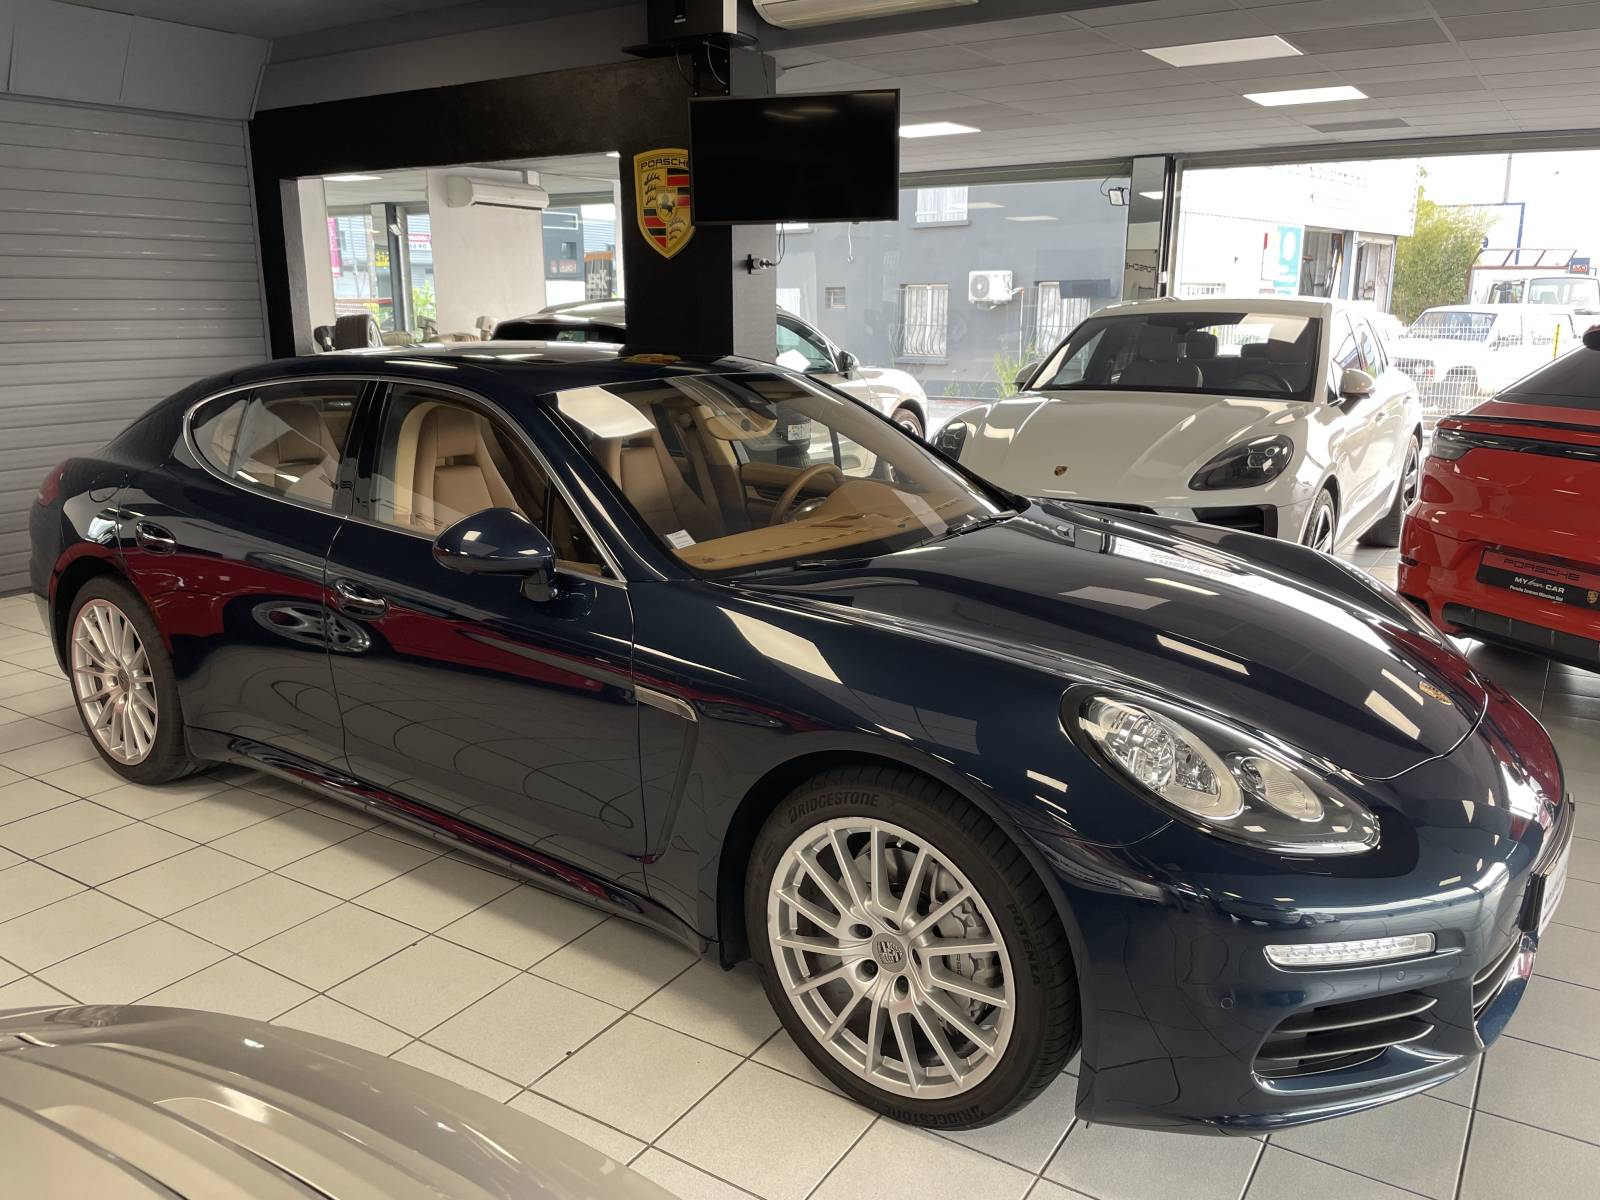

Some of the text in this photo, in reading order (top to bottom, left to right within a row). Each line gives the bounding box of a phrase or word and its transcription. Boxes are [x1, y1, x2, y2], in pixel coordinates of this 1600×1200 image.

[1504, 559, 1580, 581] PORSCHE
[1514, 576, 1528, 585] MY
[1545, 584, 1565, 594] CAR
[789, 792, 880, 824] BRIDGESTONE
[1006, 903, 1040, 985] POTENZA
